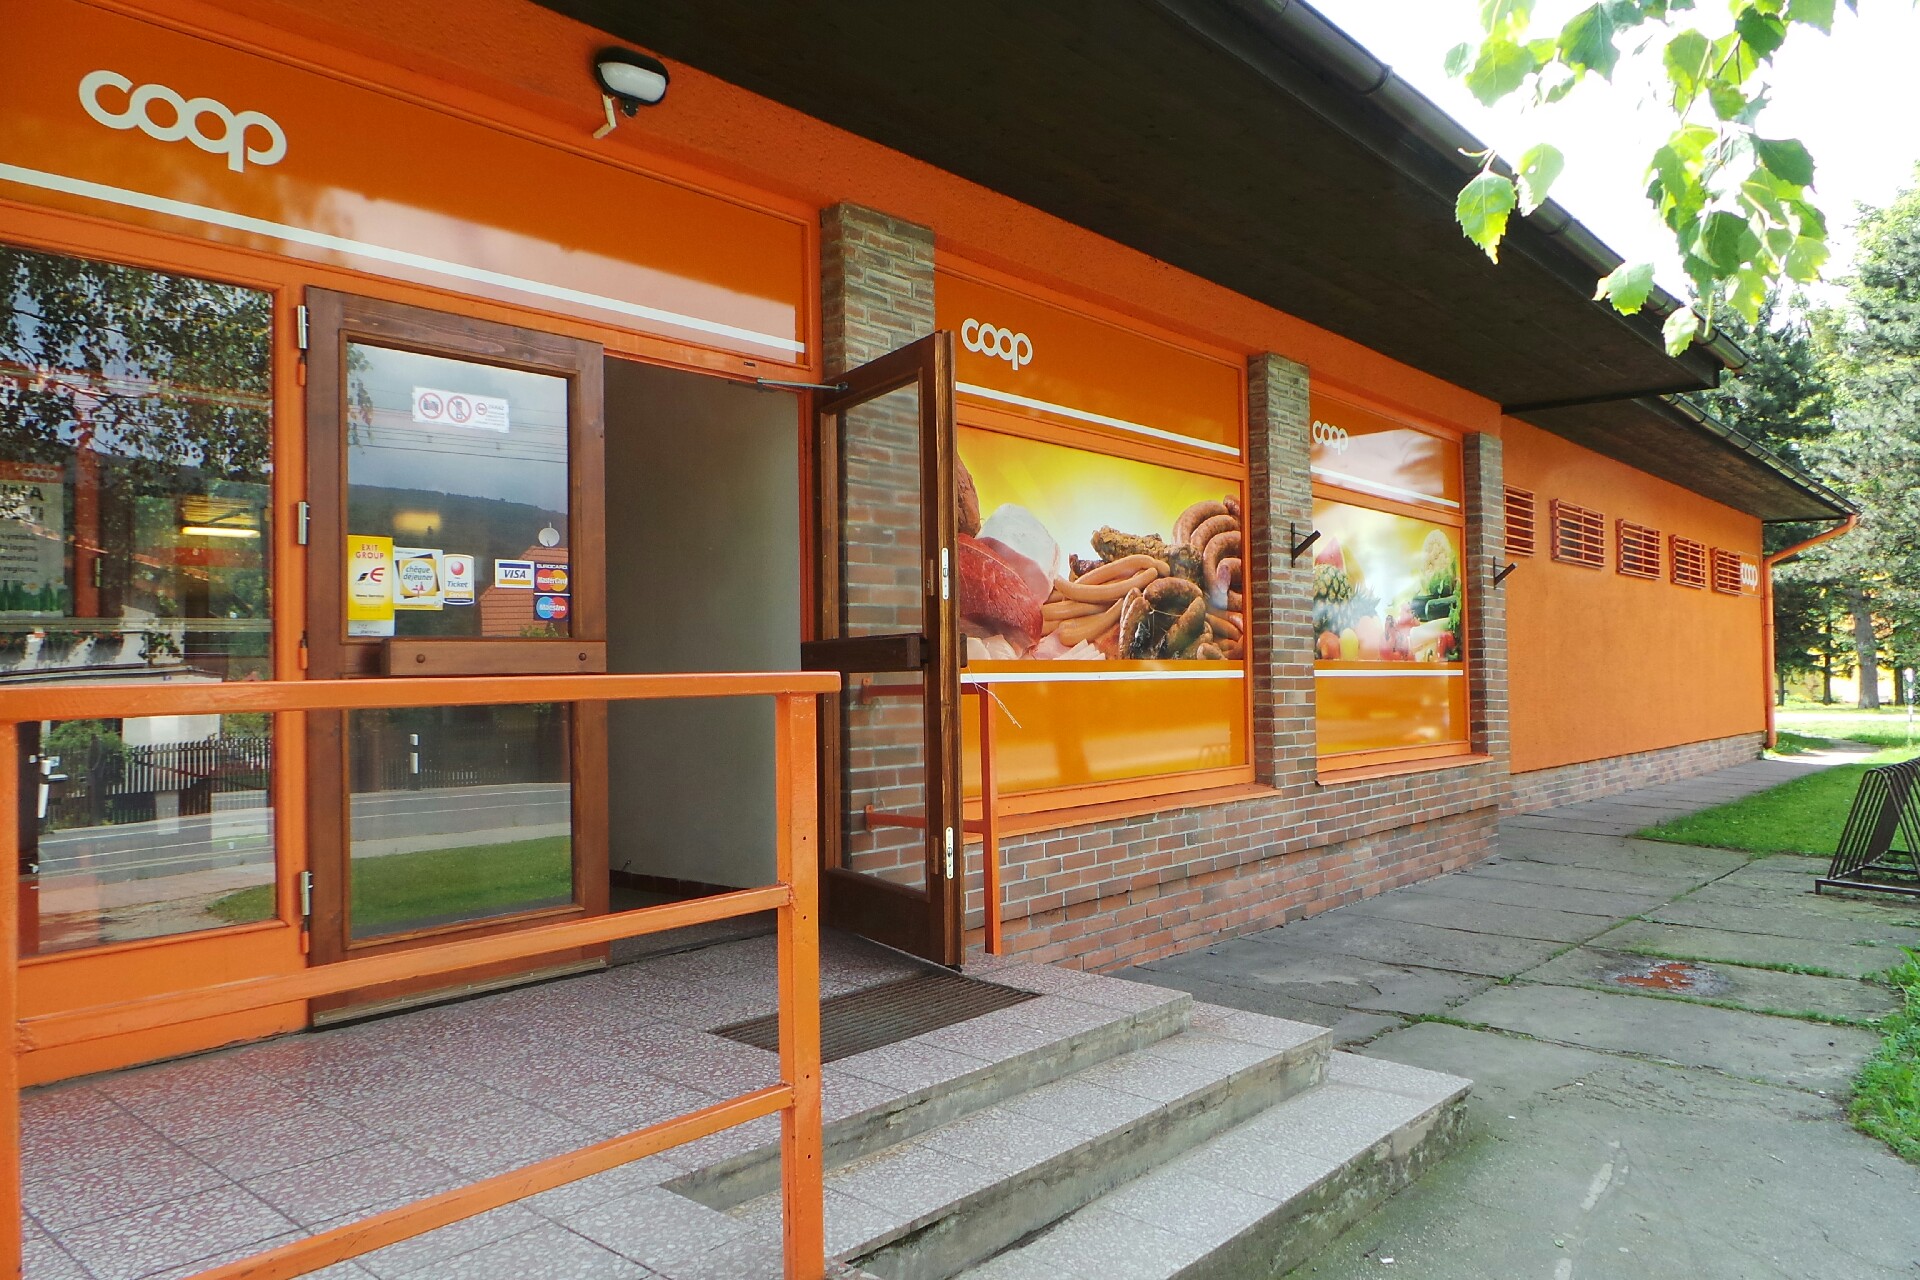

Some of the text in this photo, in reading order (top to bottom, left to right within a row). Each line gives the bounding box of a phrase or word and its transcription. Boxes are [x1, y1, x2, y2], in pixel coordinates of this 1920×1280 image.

[78, 70, 287, 173] coop
[961, 318, 1033, 370] coop
[1313, 420, 1349, 455] coop
[355, 551, 384, 559] GROUP
[504, 569, 526, 579] VISA
[537, 576, 568, 585] MasterCard
[1740, 562, 1758, 591] coop
[540, 603, 566, 612] Maestro
